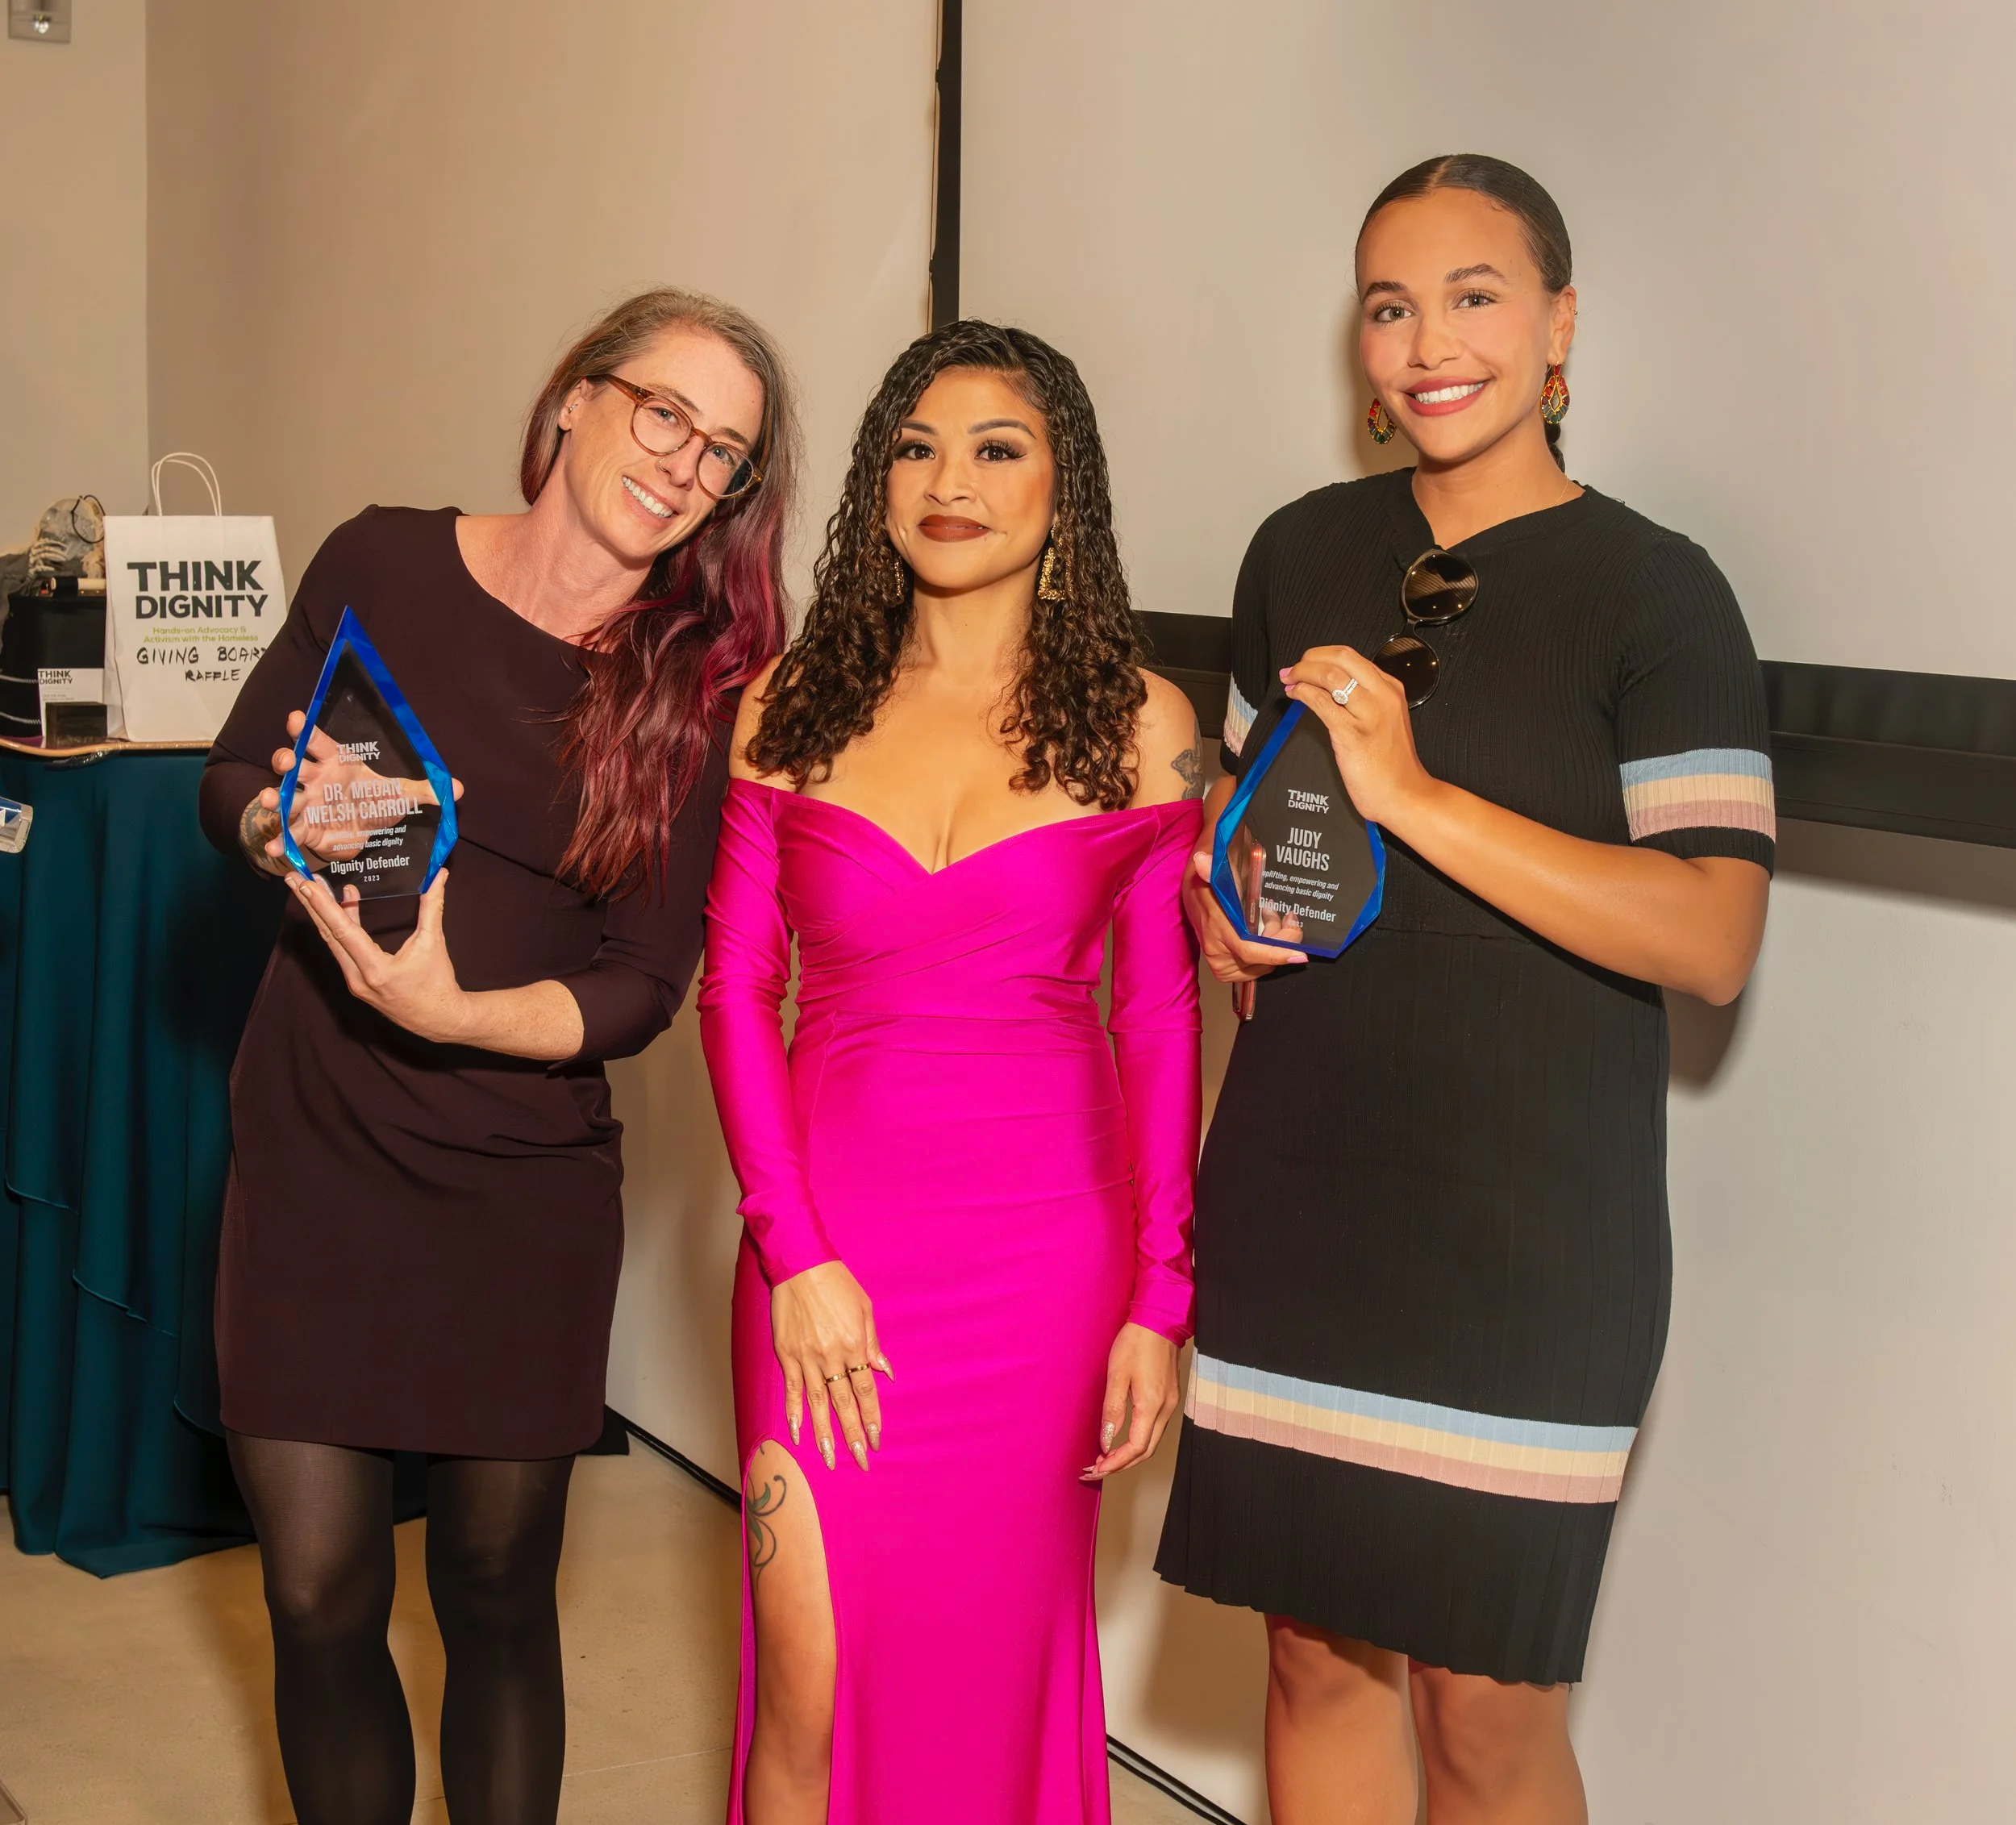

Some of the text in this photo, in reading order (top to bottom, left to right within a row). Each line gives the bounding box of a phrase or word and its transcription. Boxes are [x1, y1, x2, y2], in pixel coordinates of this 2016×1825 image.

[127, 560, 264, 592] THINK
[135, 594, 269, 619] DIGNITY
[198, 626, 238, 635] Advocacy
[219, 634, 258, 642] Homeless
[136, 646, 199, 665] GIVING
[38, 670, 71, 678] THINK
[185, 669, 240, 681] RAFFLE
[338, 741, 379, 754] THINK
[339, 752, 381, 763] DIGNITY
[323, 777, 402, 802] DR. MEGAN
[1288, 789, 1329, 806] THINK
[306, 797, 423, 824] WELSH CARROLL
[1288, 799, 1329, 814] DIGNITY
[394, 825, 406, 833] and
[1287, 827, 1322, 849] JUDY
[333, 837, 404, 852] advancing basic dignity
[331, 855, 410, 874] Dignity Defender
[1276, 844, 1331, 871] VAUGHS
[1261, 870, 1288, 881] uplifting,
[1289, 876, 1327, 890] empowering
[1264, 881, 1335, 902] advancing basic dignity
[1258, 897, 1337, 923] Dignity Defender
